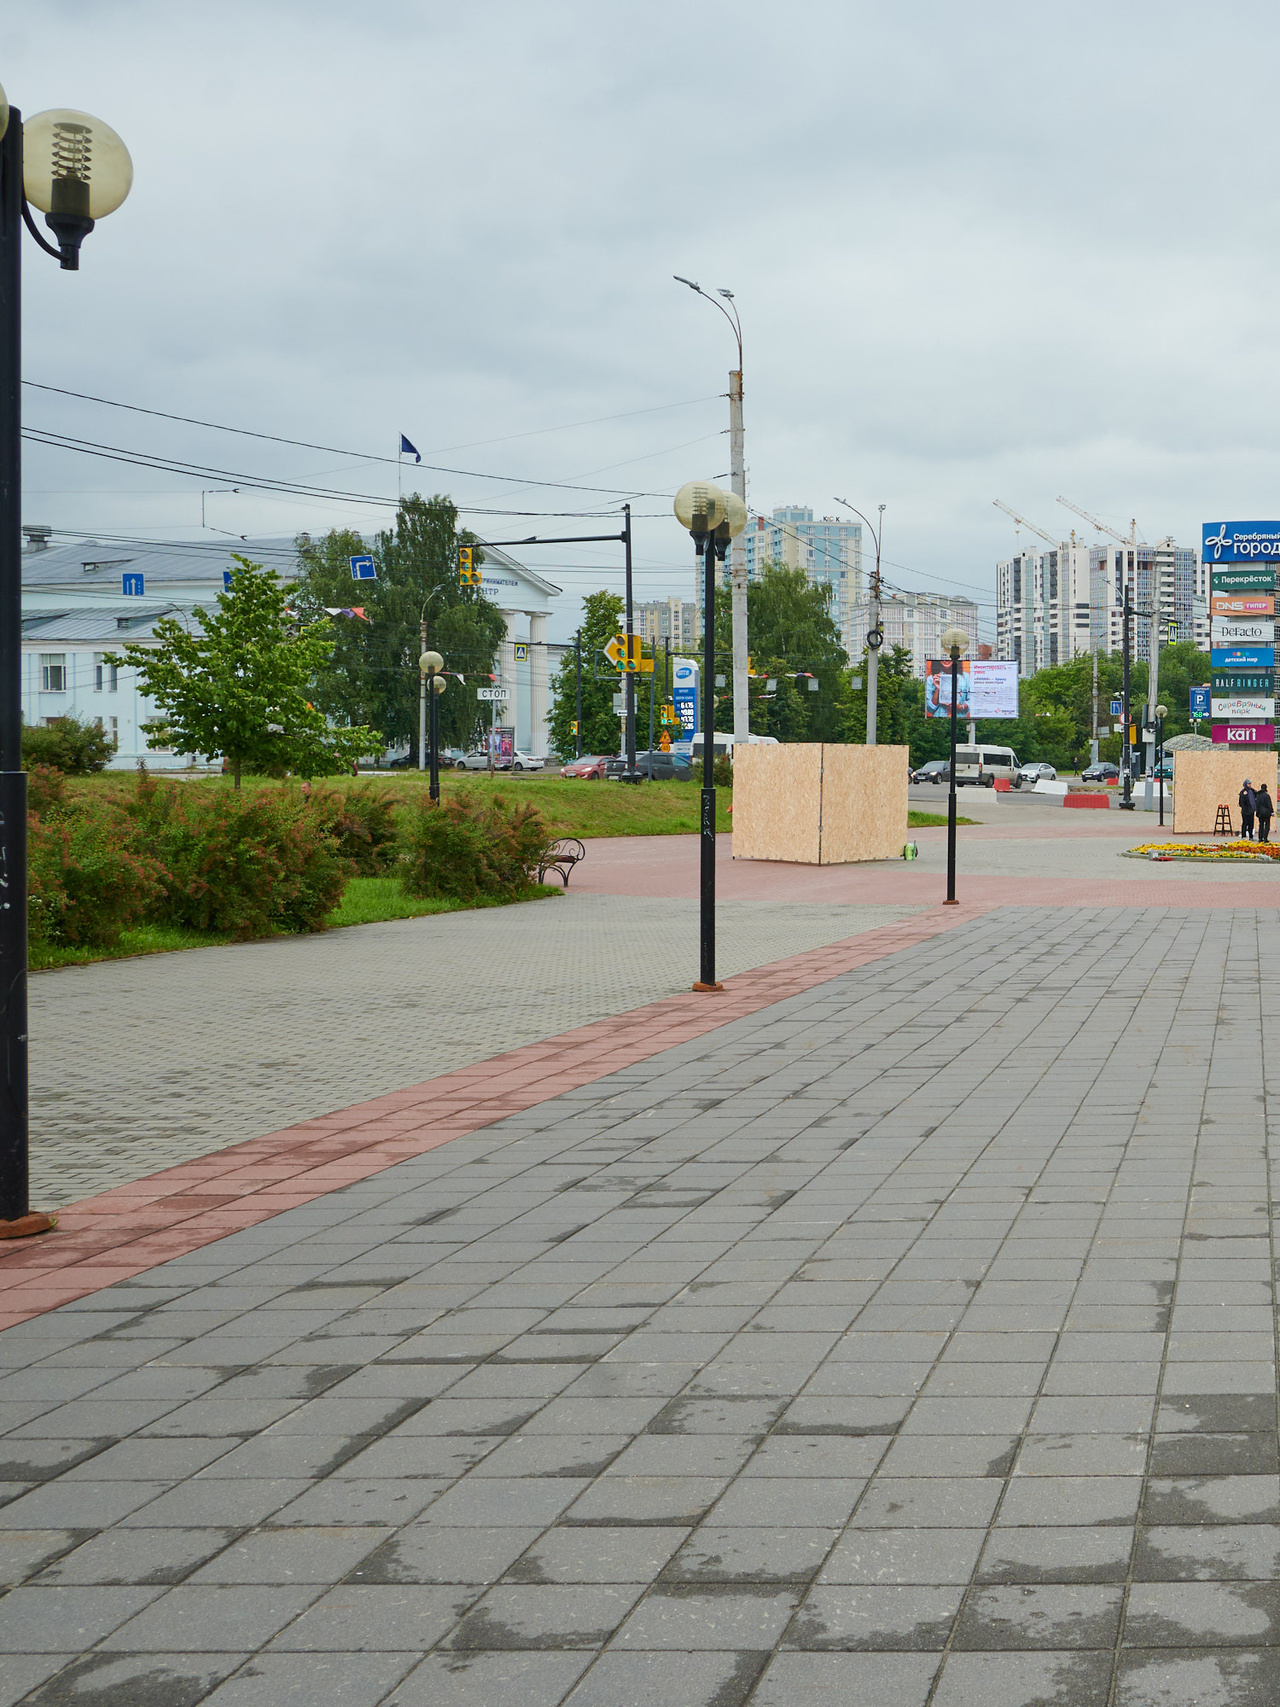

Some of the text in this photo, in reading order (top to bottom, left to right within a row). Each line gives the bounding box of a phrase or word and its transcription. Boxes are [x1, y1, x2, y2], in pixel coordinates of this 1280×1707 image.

[1221, 575, 1272, 584] Перекрёсток
[1216, 602, 1244, 610] DNS
[1221, 627, 1262, 637] DeFacto
[1215, 679, 1269, 687] RALF RINGER
[482, 690, 506, 698] СТОП
[1227, 728, 1256, 741] kari
